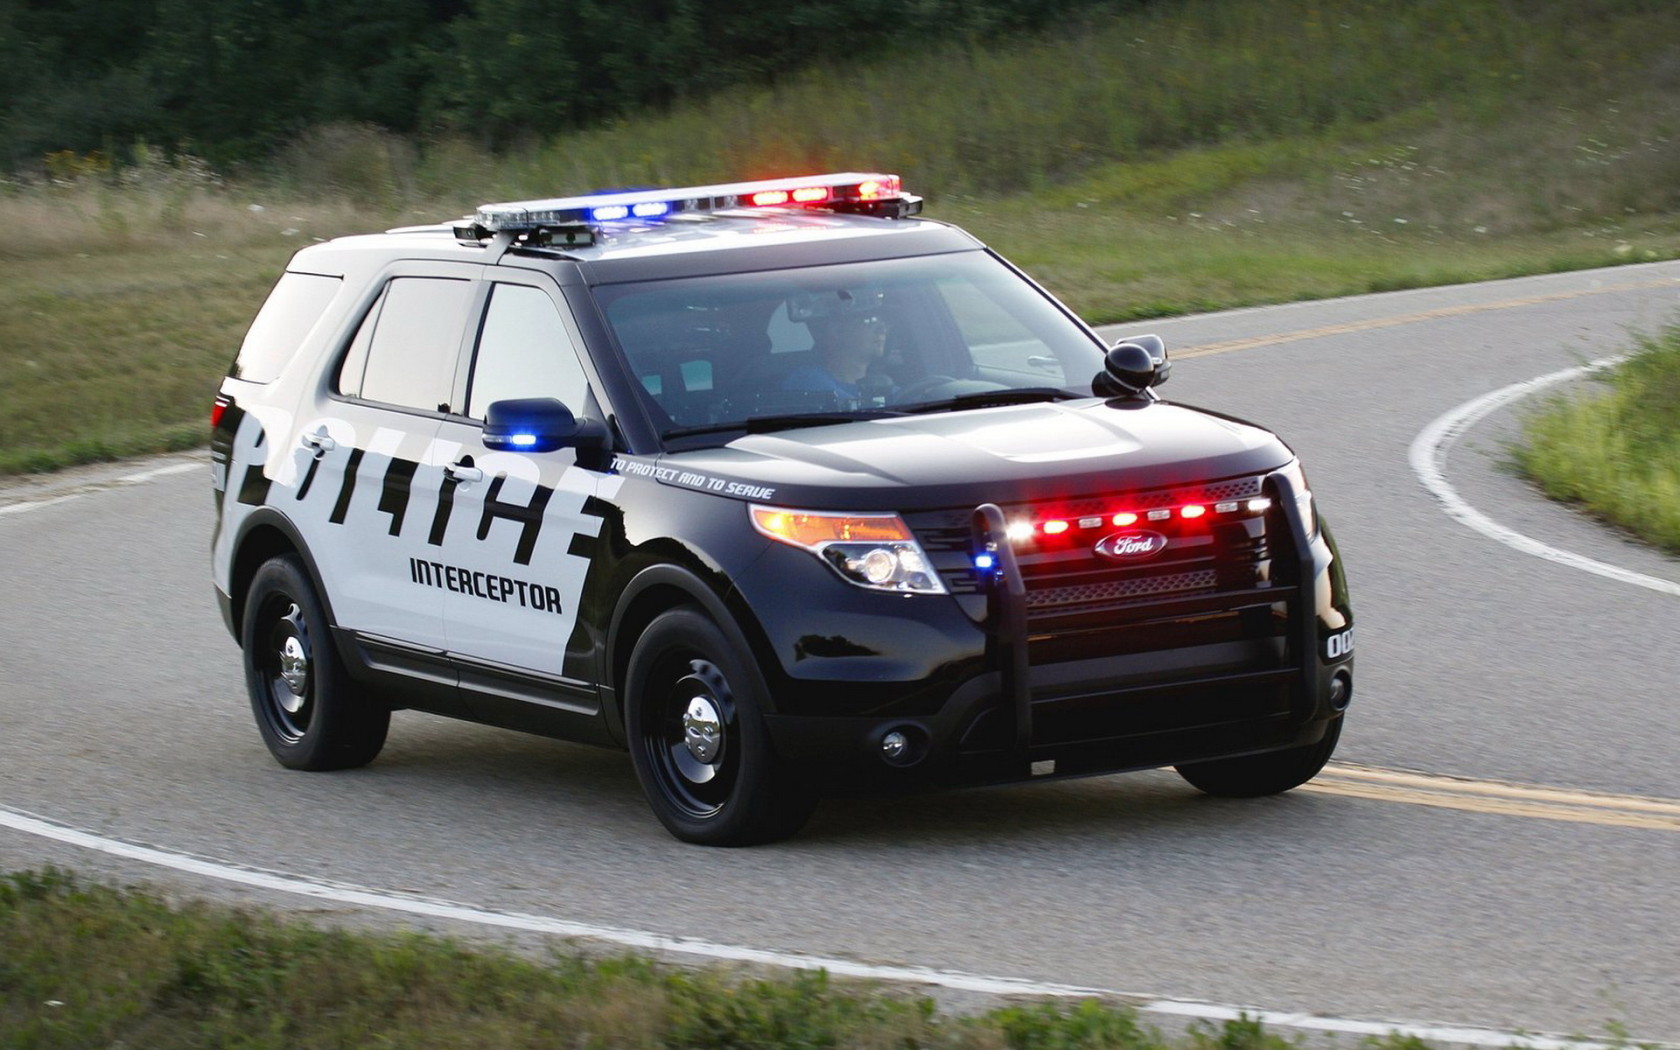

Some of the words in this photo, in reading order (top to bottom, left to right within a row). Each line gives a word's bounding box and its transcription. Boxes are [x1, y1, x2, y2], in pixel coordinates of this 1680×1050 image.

[224, 405, 626, 578] POLICE
[610, 457, 625, 470] TO
[626, 462, 680, 480] PROTECT
[678, 472, 706, 487] AND
[705, 478, 725, 491] TO
[725, 482, 776, 499] SERVE
[1113, 535, 1154, 554] Ford
[409, 557, 563, 615] INTERCEPTOR
